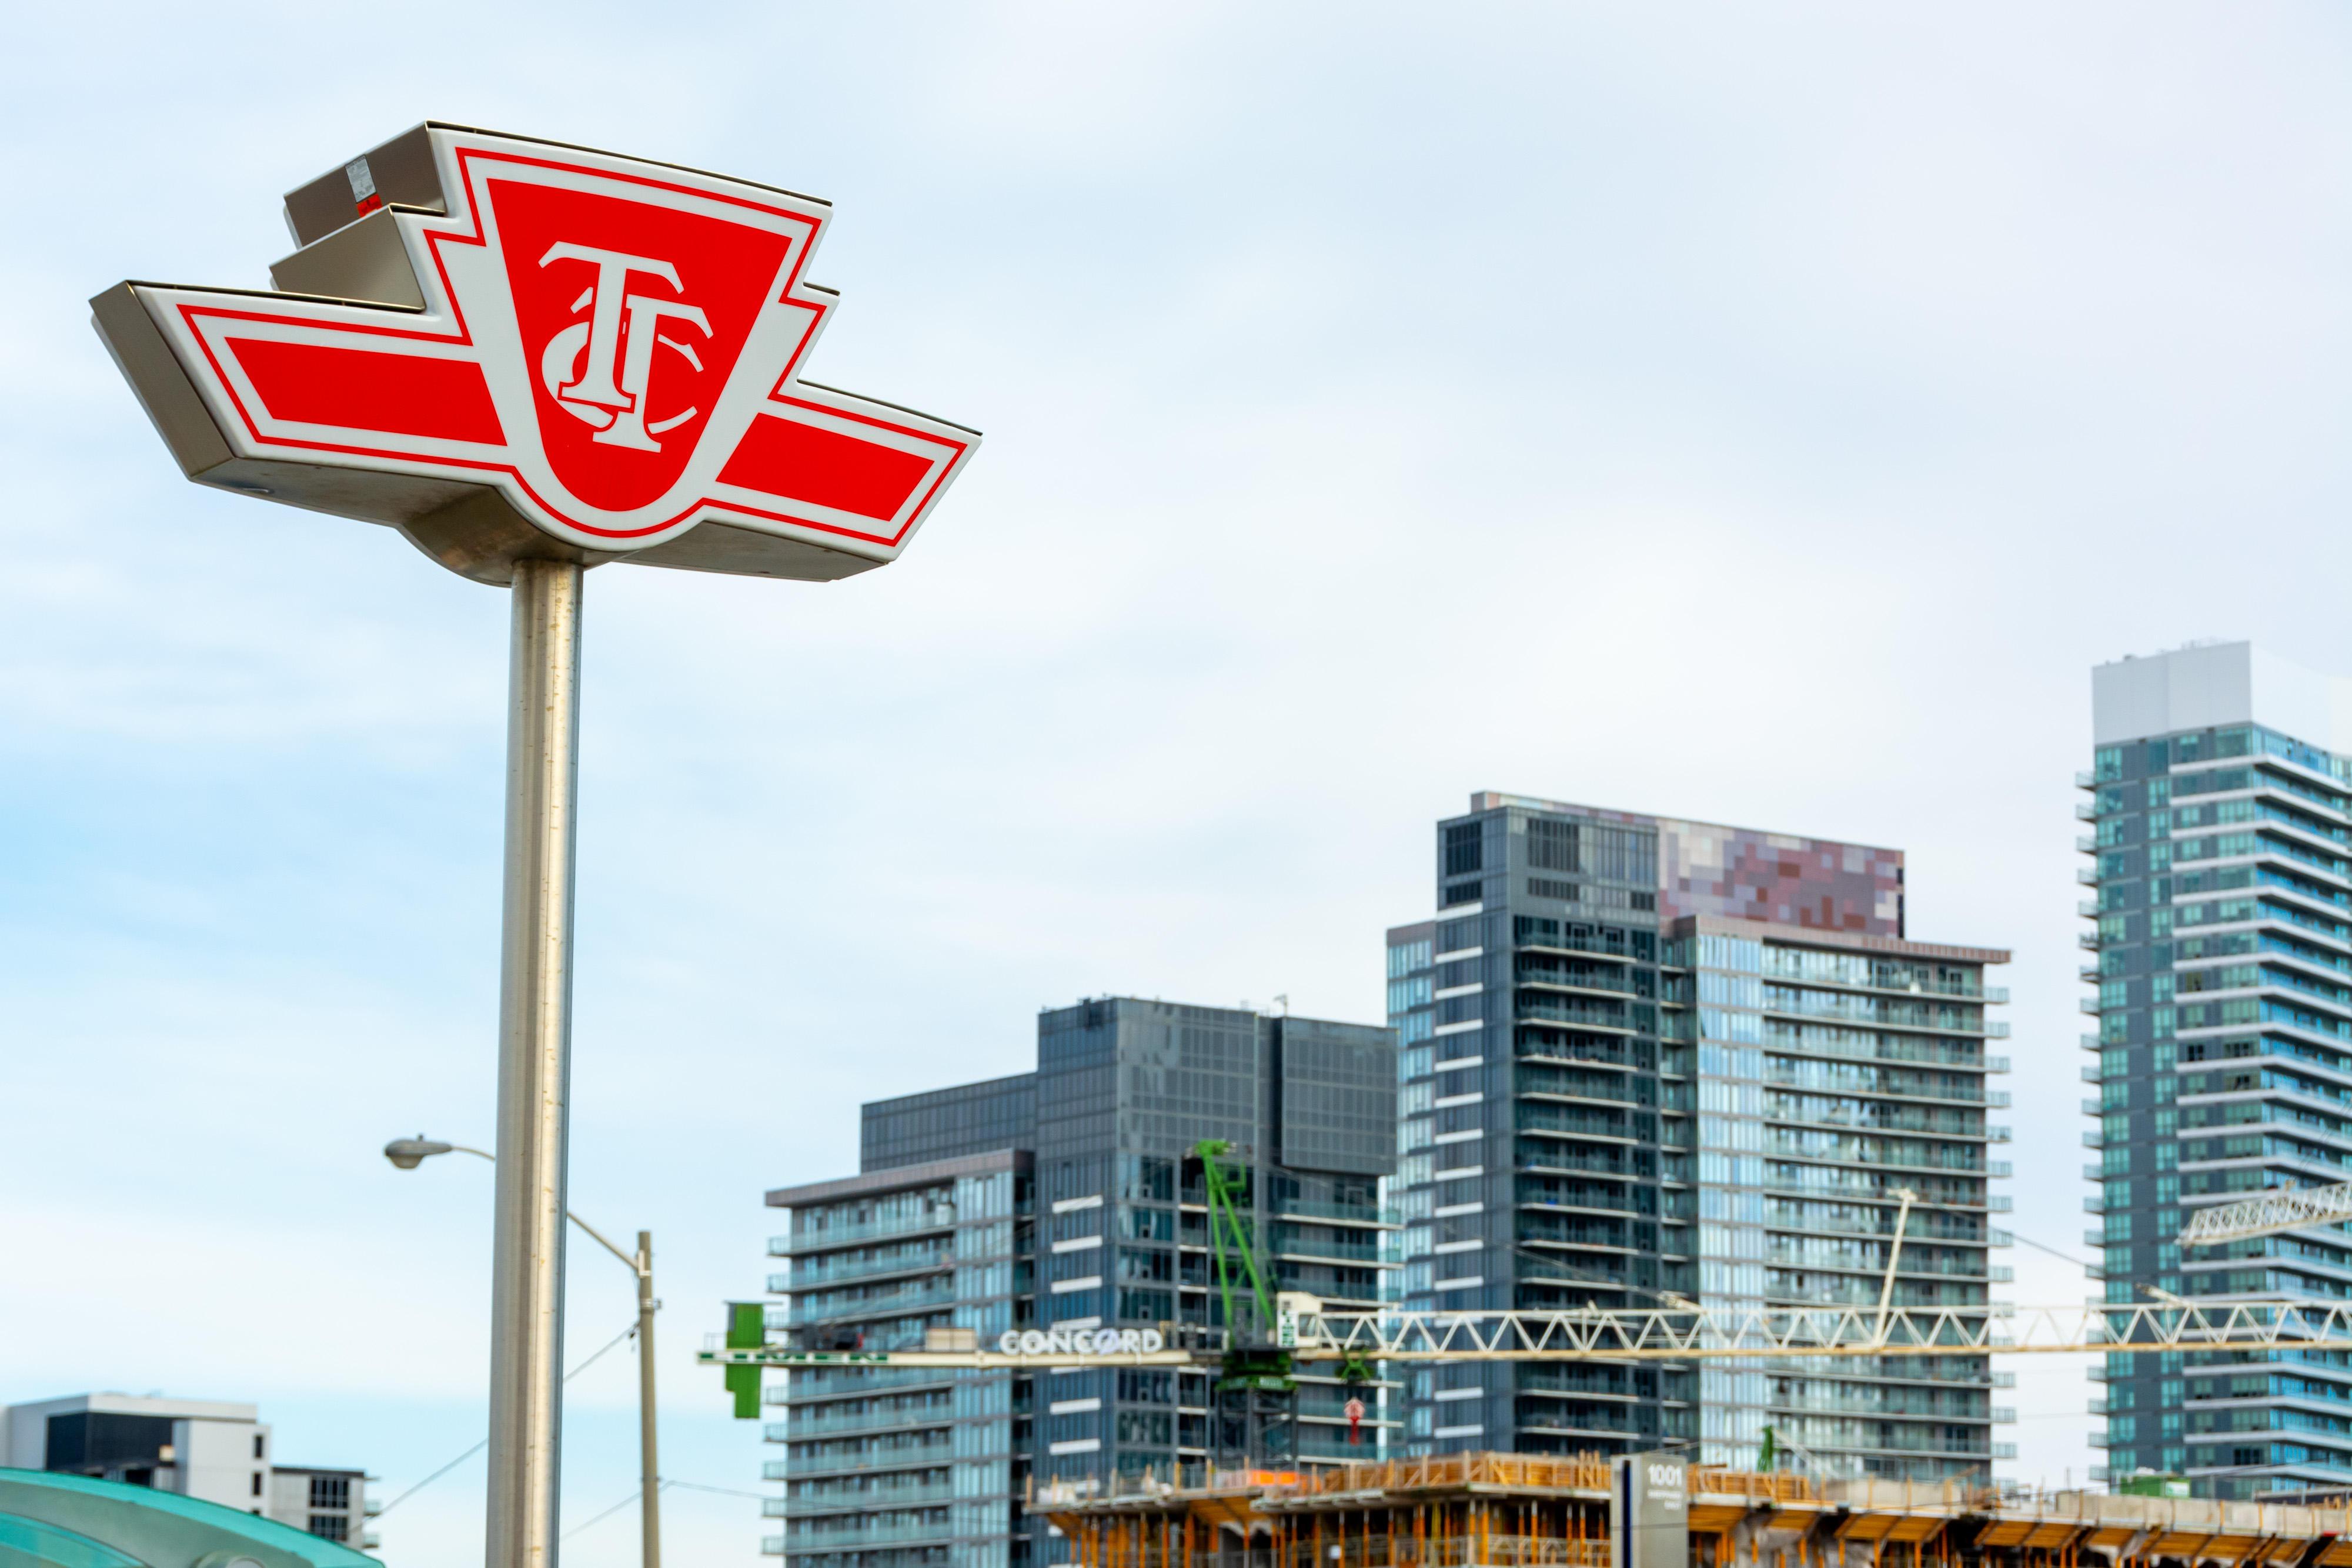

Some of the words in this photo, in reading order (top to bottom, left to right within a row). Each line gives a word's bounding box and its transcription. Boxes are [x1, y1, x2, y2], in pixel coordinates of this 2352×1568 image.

[538, 241, 713, 453] TTC
[1000, 1329, 1163, 1354] CONCORD
[1648, 1464, 1682, 1486] 1001
